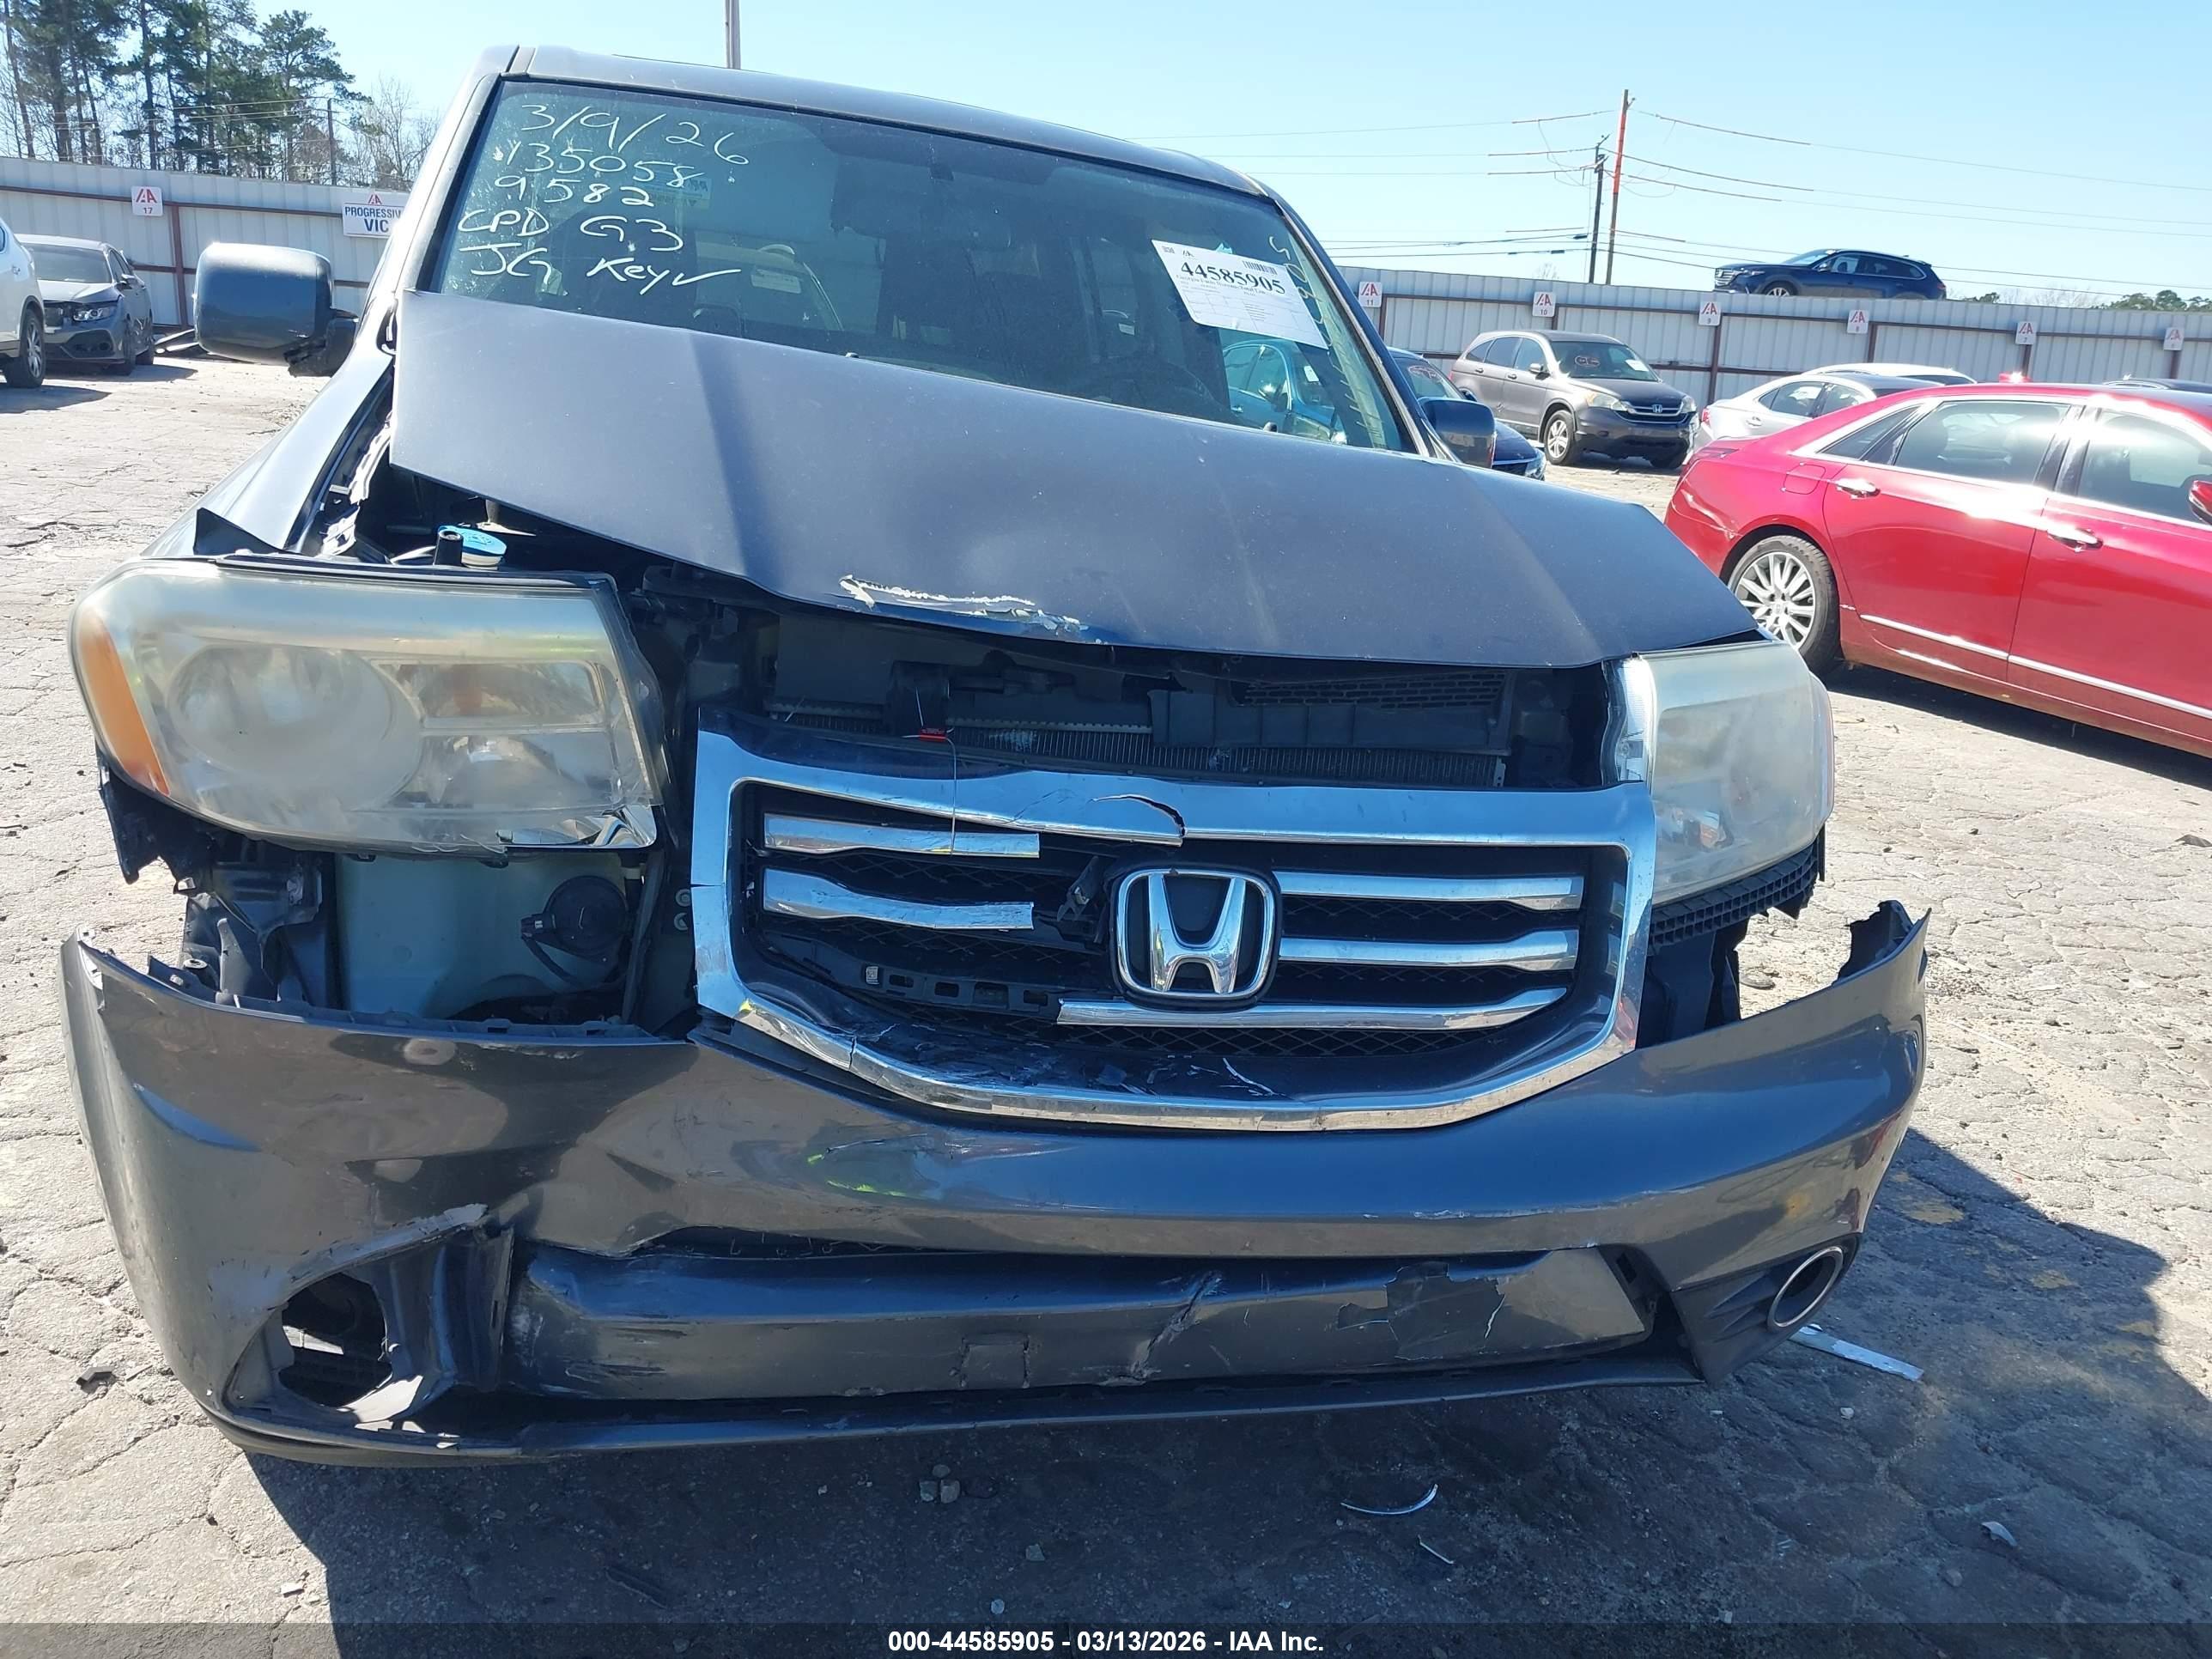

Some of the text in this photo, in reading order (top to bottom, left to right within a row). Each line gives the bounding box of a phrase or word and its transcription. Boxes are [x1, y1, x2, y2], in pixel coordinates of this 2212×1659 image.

[521, 105, 750, 165] 3/9/26
[494, 176, 654, 208] 9582
[344, 206, 402, 219] PROGRESSIV
[363, 218, 389, 233] VIC
[586, 258, 671, 295] Key
[1181, 261, 1285, 295] 44585905
